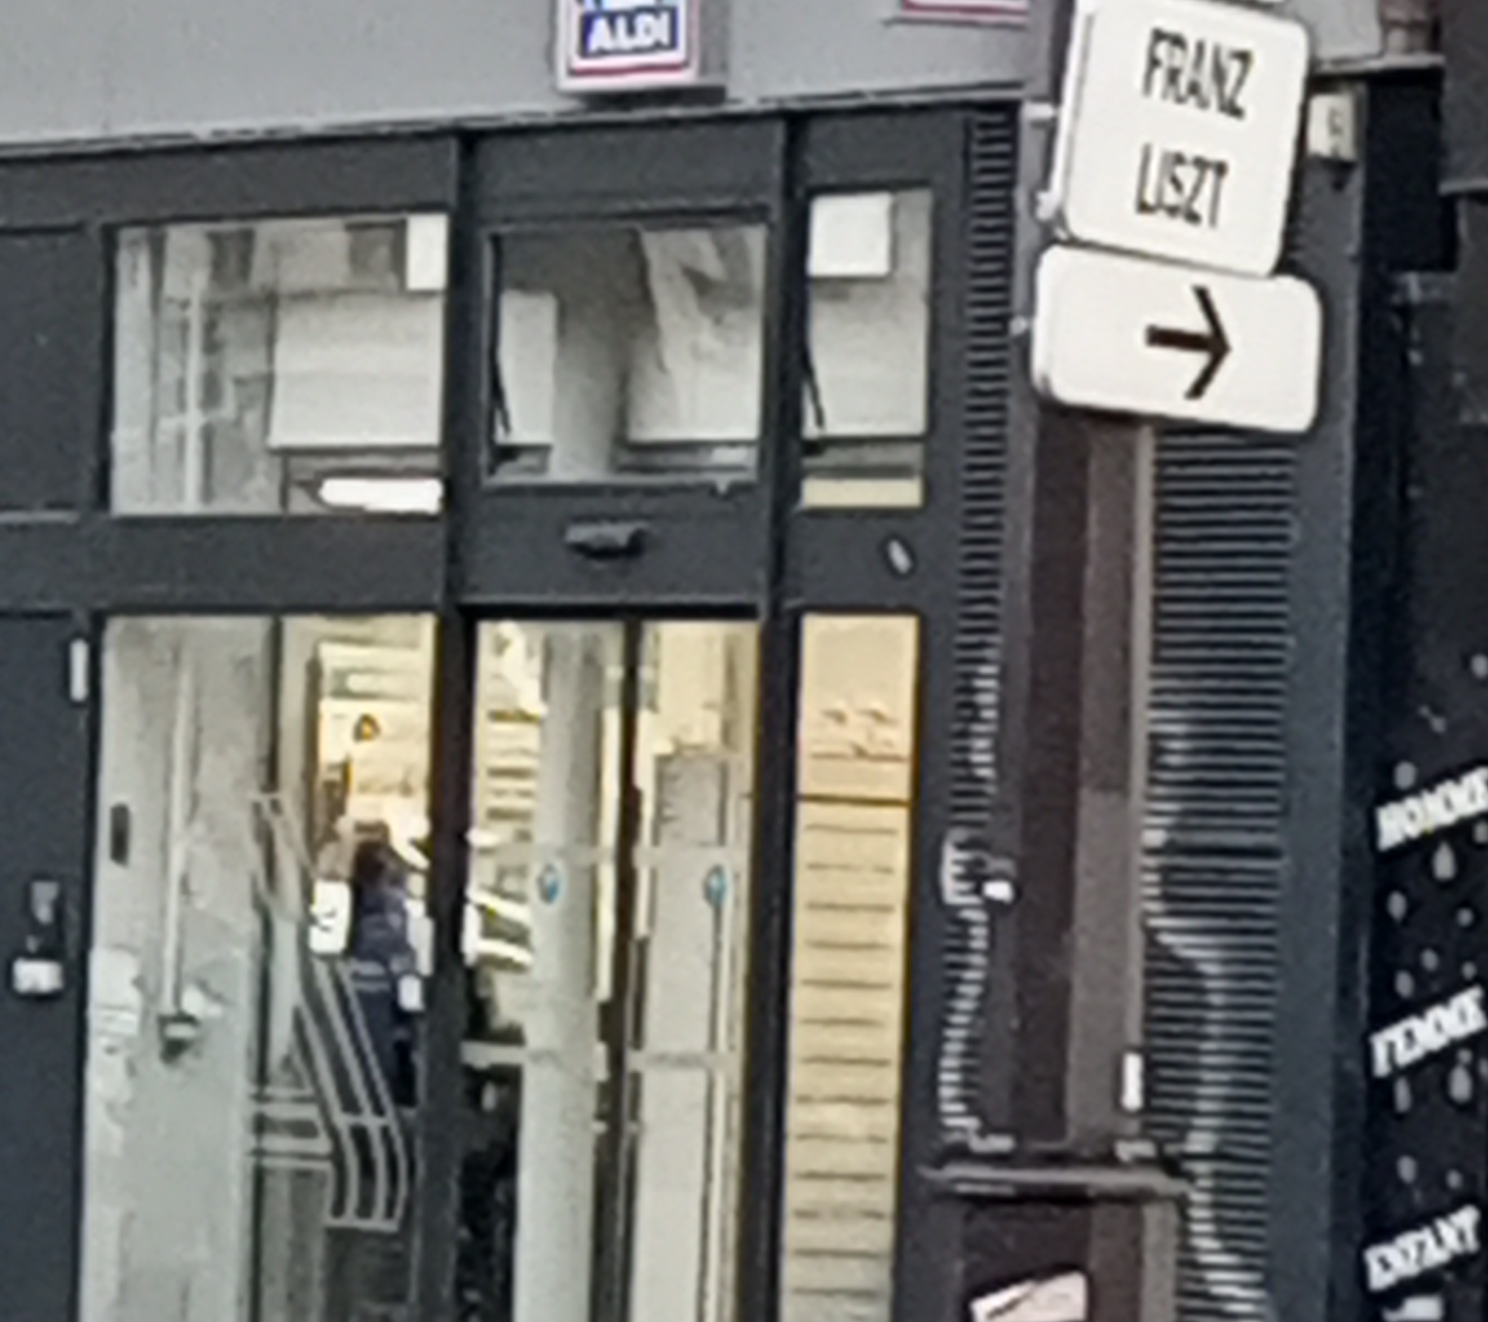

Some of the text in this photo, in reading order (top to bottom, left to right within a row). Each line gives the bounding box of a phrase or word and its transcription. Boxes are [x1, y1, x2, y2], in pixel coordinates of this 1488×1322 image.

[587, 11, 670, 53] ALDI
[1143, 28, 1252, 120] FRANZ
[1135, 145, 1227, 227] LISZT
